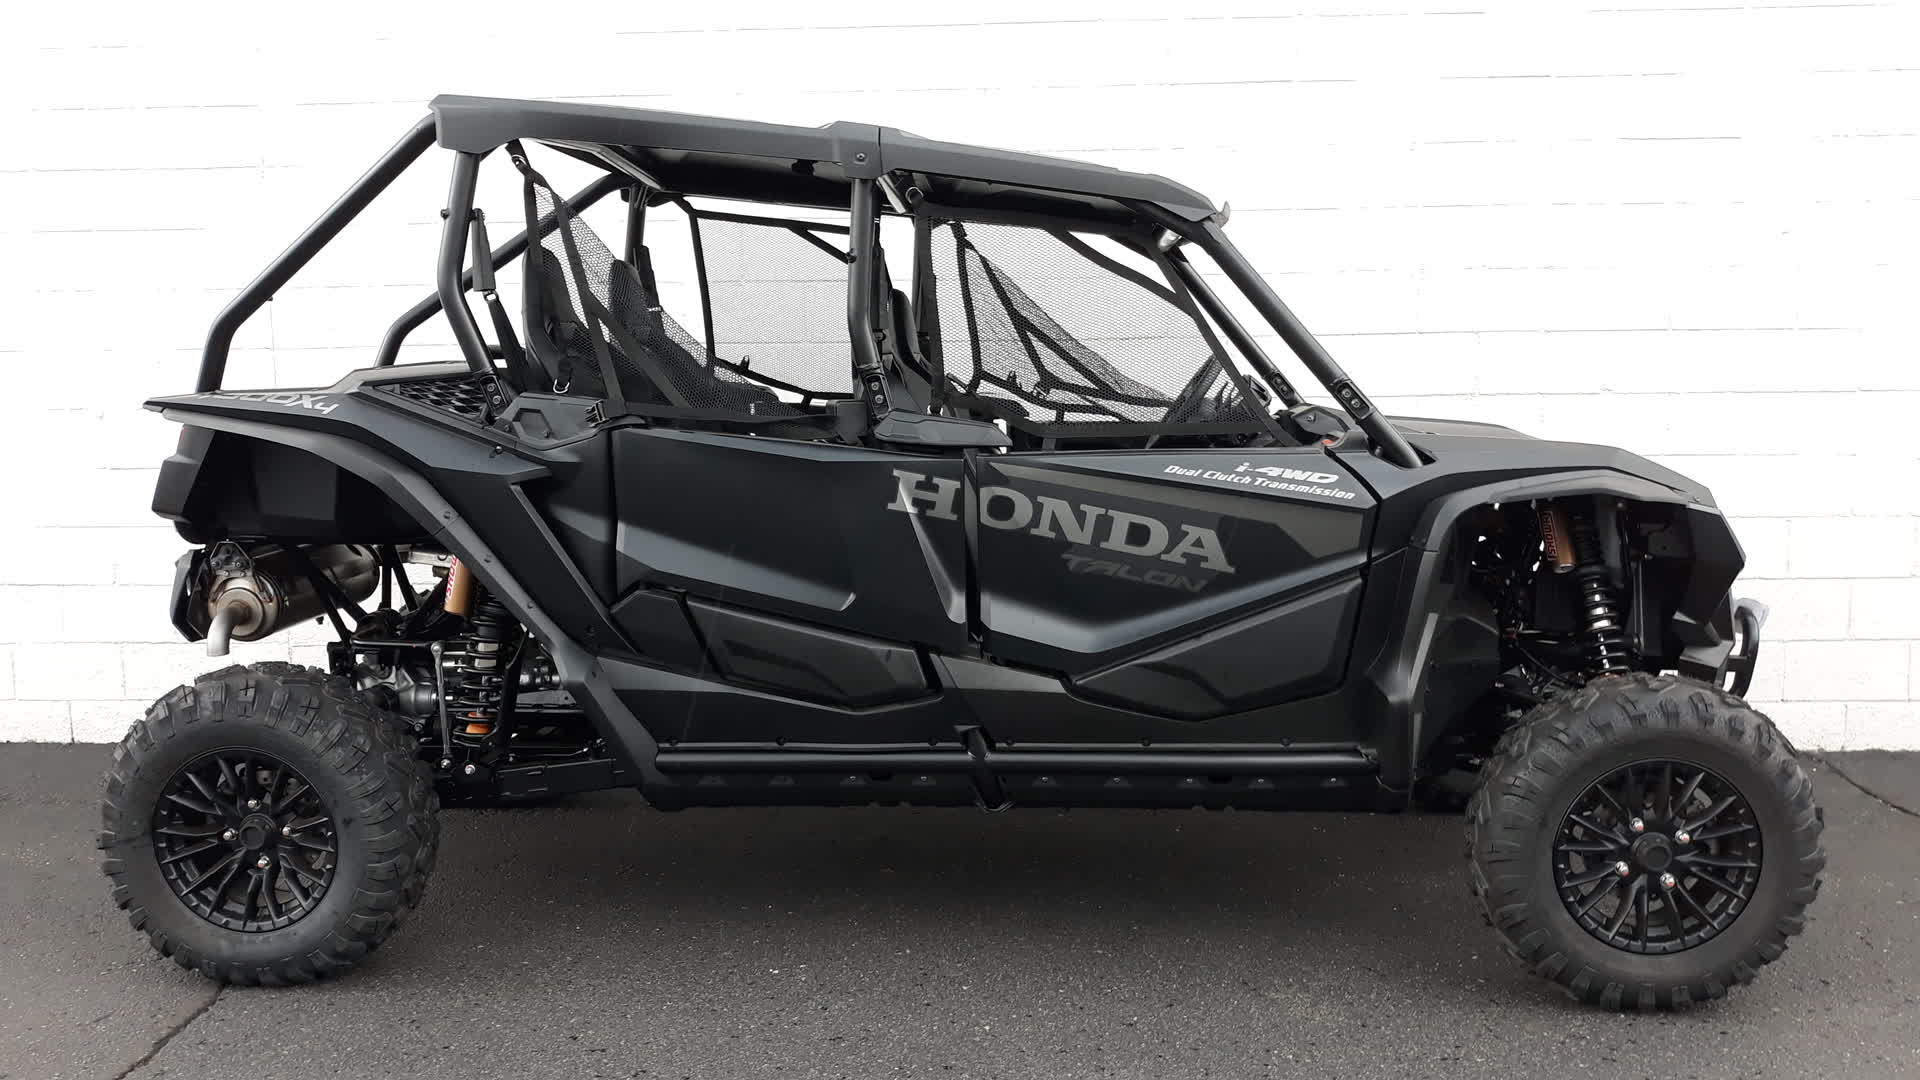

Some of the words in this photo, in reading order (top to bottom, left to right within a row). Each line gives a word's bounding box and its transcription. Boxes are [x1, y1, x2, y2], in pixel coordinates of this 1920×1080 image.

[1164, 465, 1201, 477] Dual
[1202, 470, 1251, 485] Clutch
[1254, 477, 1356, 500] Transmission
[1235, 462, 1339, 484] i-4WD
[887, 468, 1236, 574] HONDA
[1060, 552, 1209, 593] TALON
